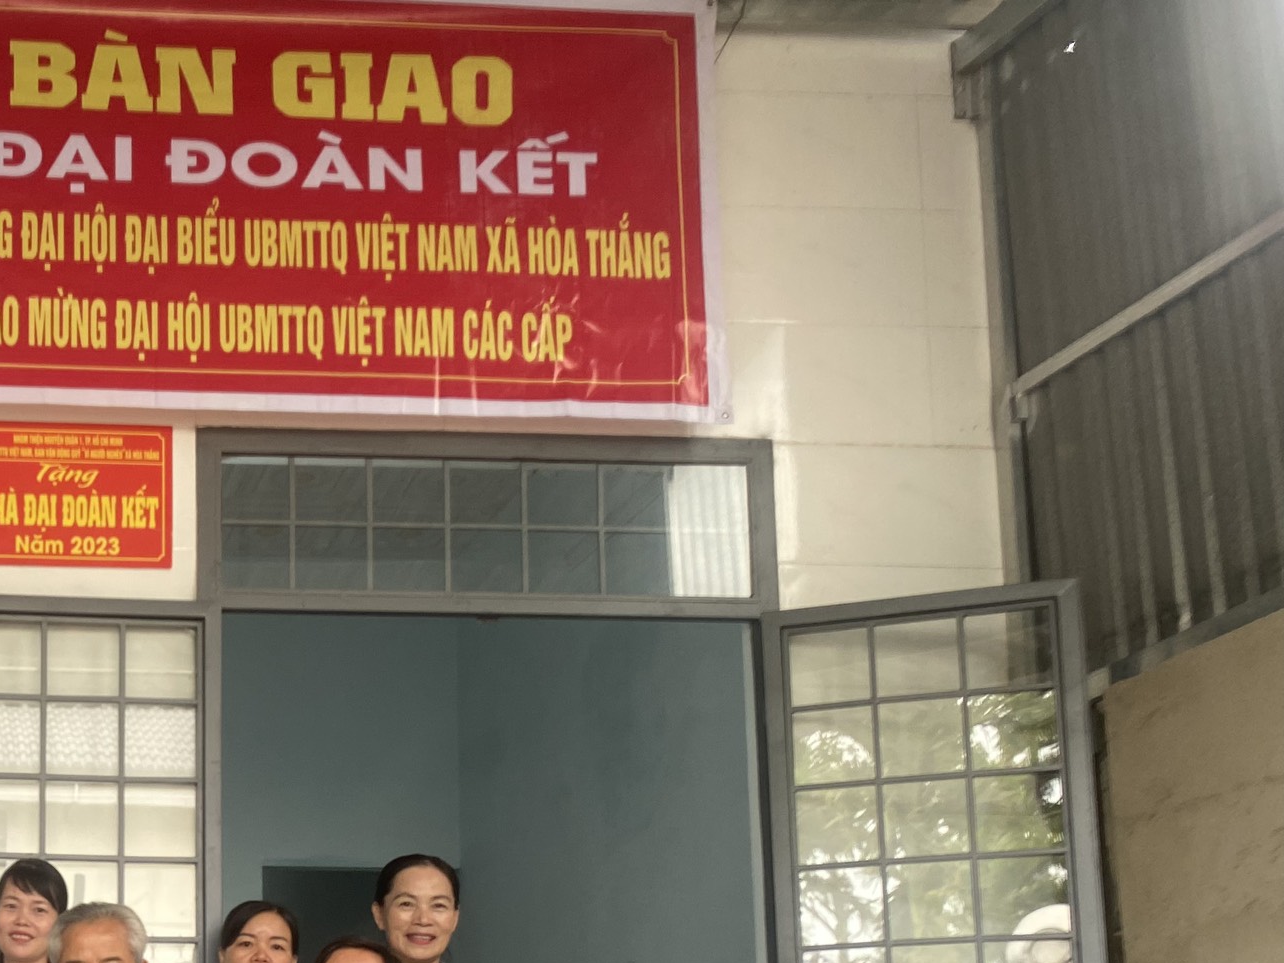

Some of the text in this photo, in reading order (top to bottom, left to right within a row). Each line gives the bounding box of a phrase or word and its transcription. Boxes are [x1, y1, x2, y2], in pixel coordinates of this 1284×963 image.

[10, 30, 236, 114] BÀN
[273, 52, 512, 125] GIAO
[166, 131, 423, 191] ĐOÀN
[460, 132, 597, 196] KẾT
[21, 212, 64, 271] ĐẠI
[74, 203, 116, 273] HỘI
[125, 215, 168, 274] ĐẠI
[177, 198, 235, 266] BIỂU
[245, 220, 347, 275] UBMTTQ
[356, 213, 409, 281] VIỆT
[418, 224, 478, 272] NAM
[486, 217, 521, 274] XÃ
[528, 216, 579, 276] HÒA
[586, 213, 671, 280] THẮNG
[28, 288, 106, 349] MỪNG
[115, 300, 158, 361] ĐẠI
[168, 292, 210, 363] HỘI
[220, 304, 324, 360] UBMTTQ
[332, 296, 386, 367] VIỆT
[395, 307, 454, 362] NAM
[463, 300, 514, 362] CÁC
[521, 297, 573, 363] CẤP
[36, 462, 99, 488] Tặng
[24, 493, 58, 533] ĐẠI
[62, 489, 116, 529] ĐOÀN
[121, 484, 159, 530] KẾT
[15, 535, 121, 557] Năm 2023
